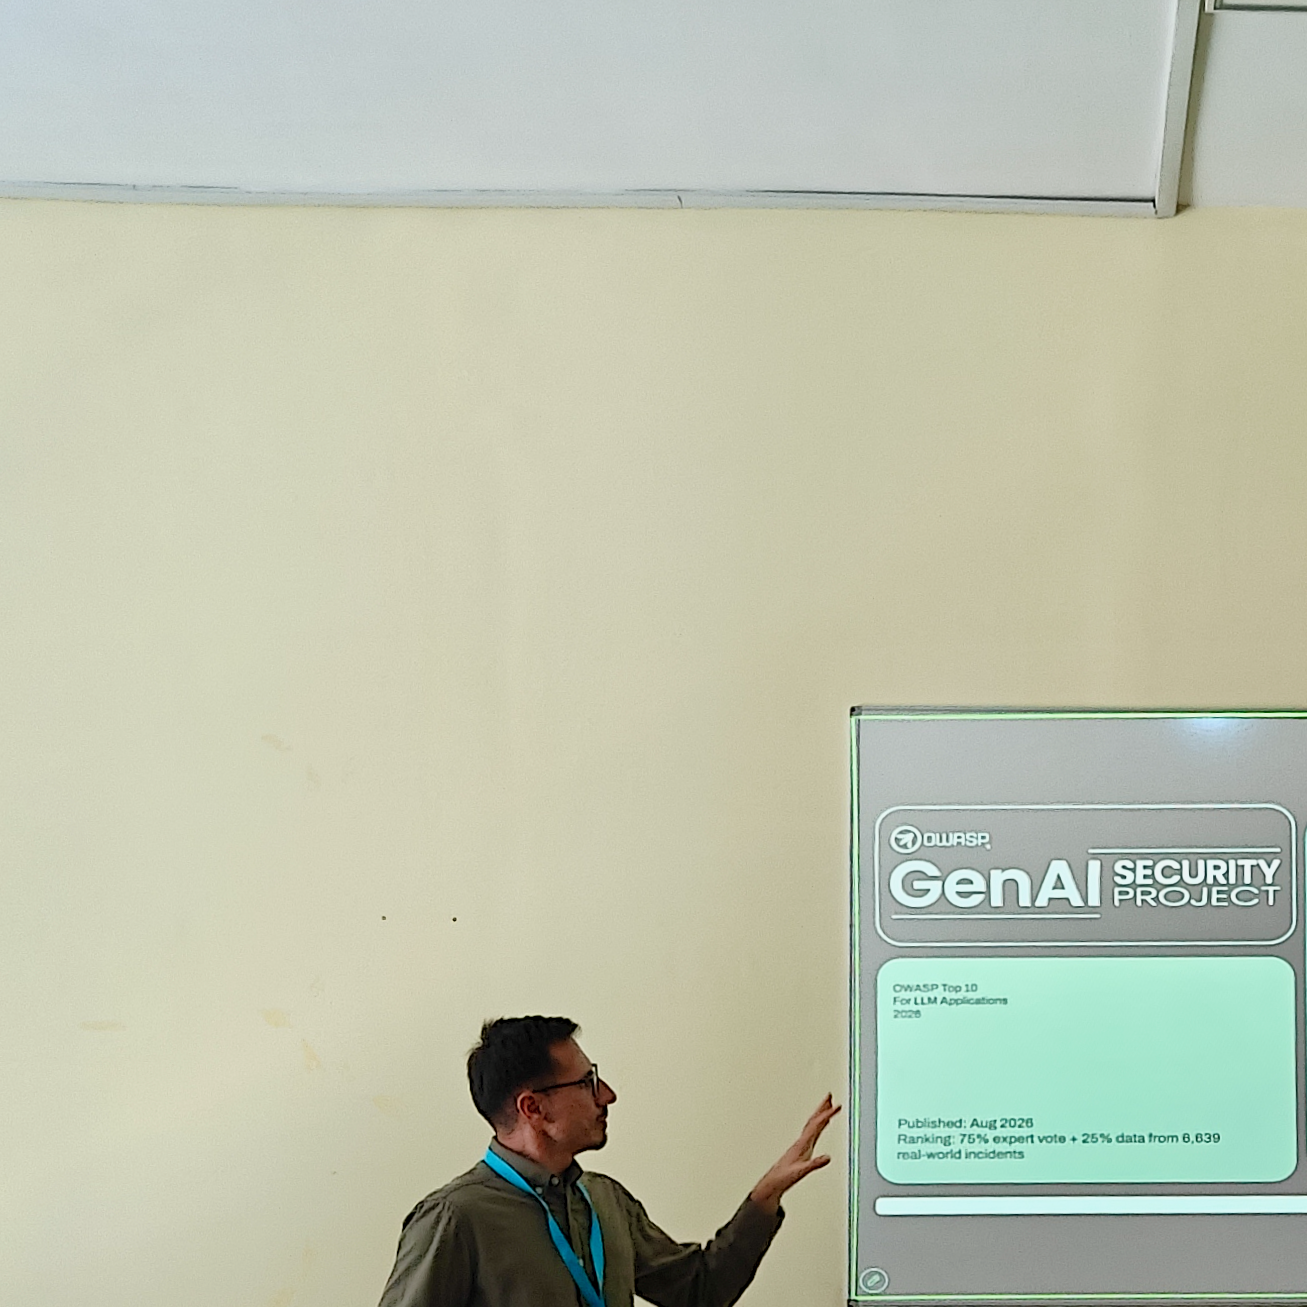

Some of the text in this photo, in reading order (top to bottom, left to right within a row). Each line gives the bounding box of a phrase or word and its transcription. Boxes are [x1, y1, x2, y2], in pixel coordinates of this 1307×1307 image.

[1112, 858, 1281, 886] SECURITY
[889, 859, 1102, 909] GenAI
[1113, 885, 1281, 908] PROJECT
[892, 983, 978, 994] OWASP Top 10
[893, 996, 1009, 1007] For LLM Applications
[897, 1117, 1035, 1131] Published: Aug 2026
[897, 1133, 956, 1147] Ranking:
[958, 1132, 990, 1145] 75%
[992, 1133, 1035, 1147] expert
[1037, 1133, 1067, 1145] vote
[1081, 1132, 1113, 1145] 25%
[1115, 1132, 1146, 1145] data
[1148, 1132, 1180, 1145] from
[896, 1148, 1026, 1161] real-world incidents
